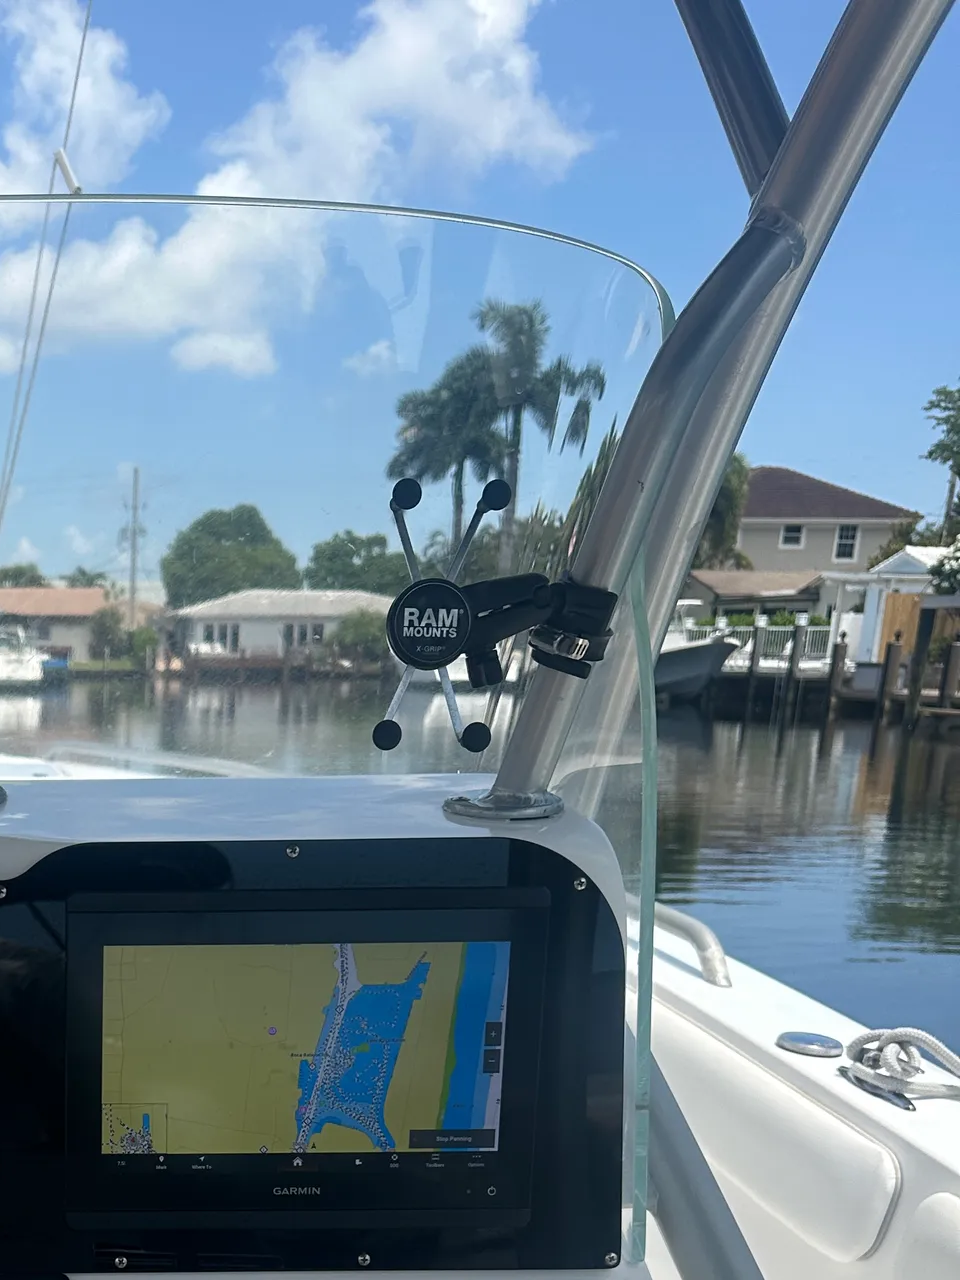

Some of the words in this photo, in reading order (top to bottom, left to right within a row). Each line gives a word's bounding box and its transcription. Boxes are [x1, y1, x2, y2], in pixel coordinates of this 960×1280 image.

[404, 607, 459, 628] RAM
[402, 626, 457, 638] MOUNTS
[273, 1187, 320, 1196] GARMIN
